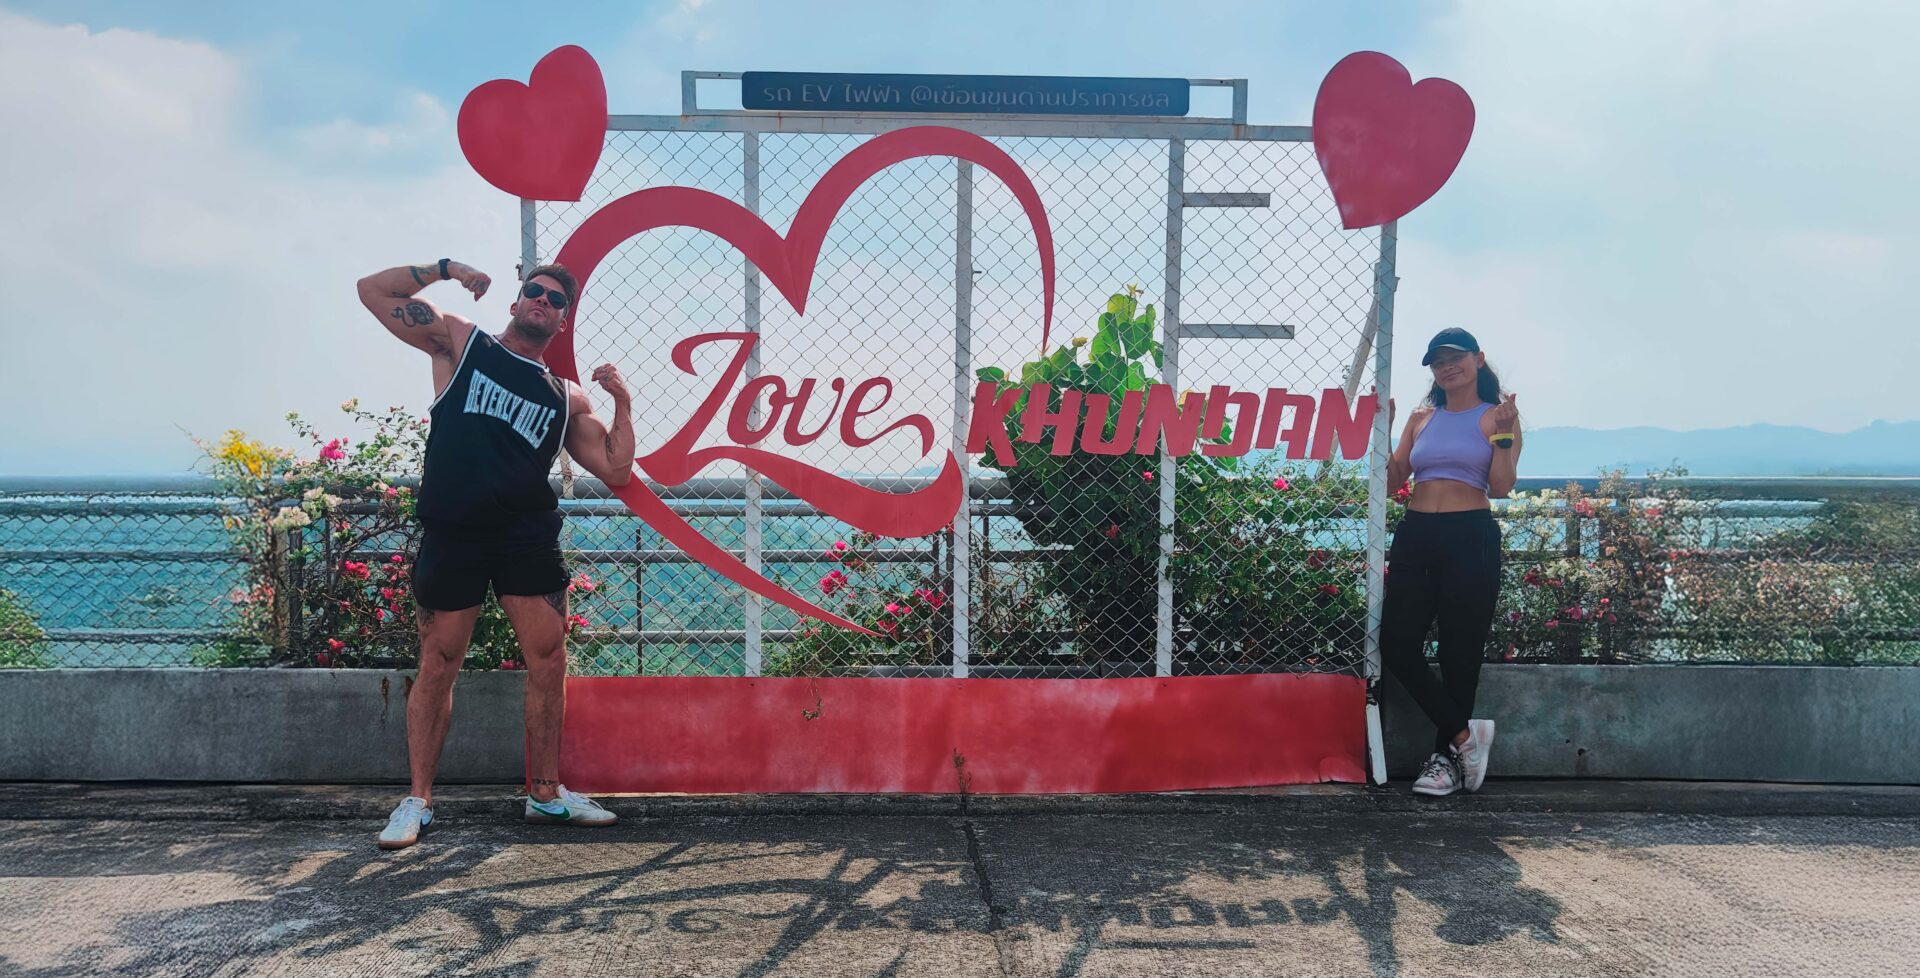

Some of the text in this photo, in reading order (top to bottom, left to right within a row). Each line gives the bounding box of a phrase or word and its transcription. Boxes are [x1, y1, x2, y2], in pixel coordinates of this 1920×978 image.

[763, 87, 792, 102] รถ
[802, 83, 834, 102] EV
[463, 368, 557, 450] BEVERLY HILLS
[634, 331, 1379, 538] Love KHUNDAN
